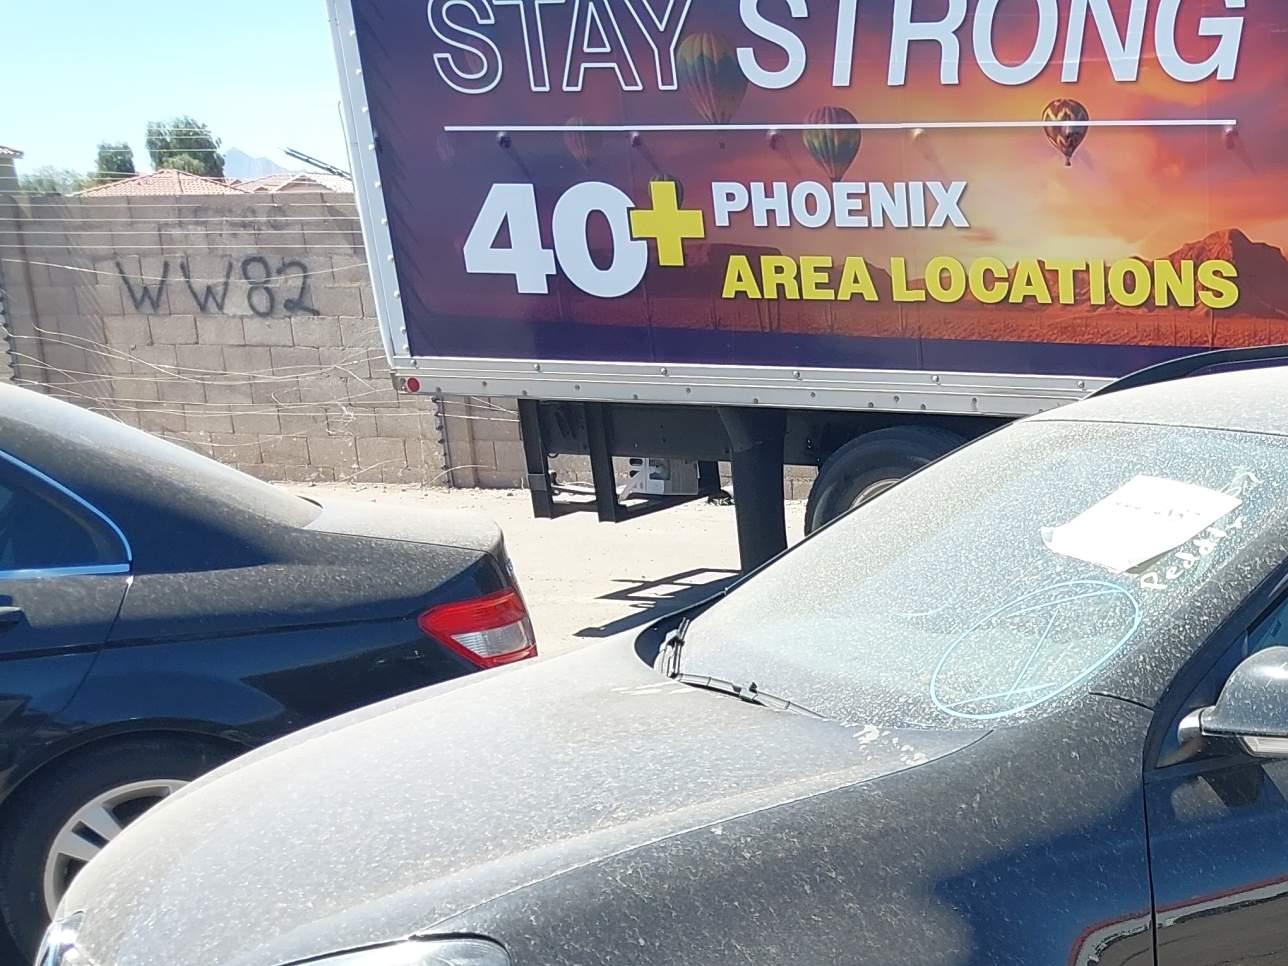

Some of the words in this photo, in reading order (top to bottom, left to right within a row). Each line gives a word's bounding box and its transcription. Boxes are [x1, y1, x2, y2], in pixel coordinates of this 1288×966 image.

[427, 0, 692, 95] STAY
[735, 0, 1248, 90] STRONG
[462, 180, 705, 298] 40+
[711, 179, 970, 229] PHOENIX
[721, 254, 879, 301] AREA
[891, 255, 1240, 308] LOCATIONS
